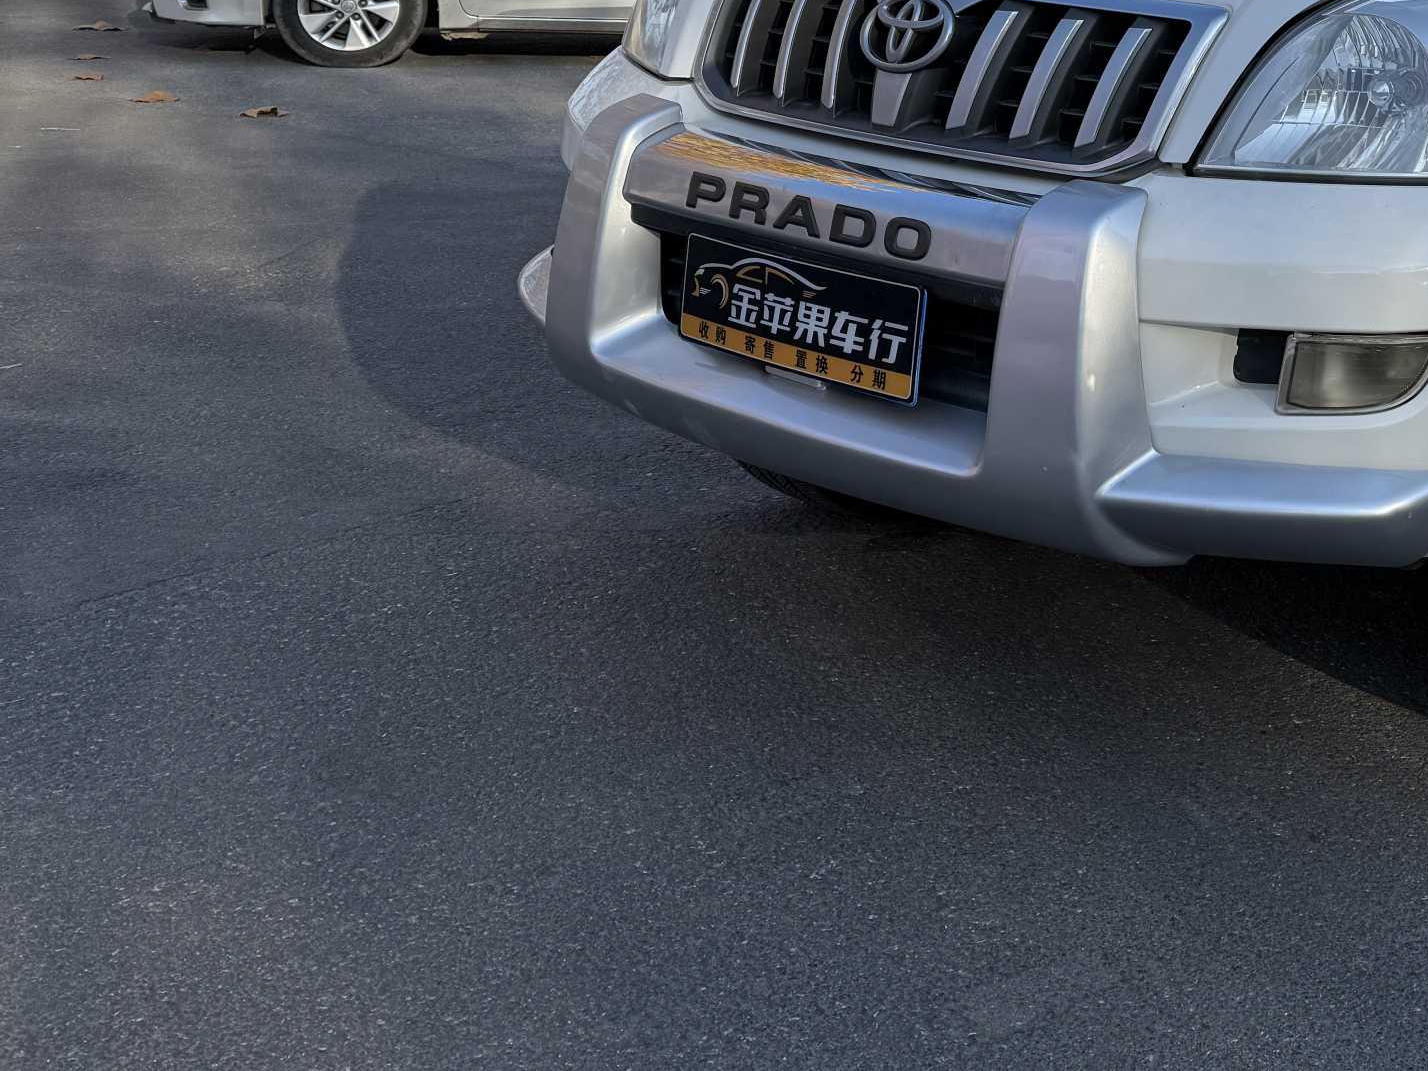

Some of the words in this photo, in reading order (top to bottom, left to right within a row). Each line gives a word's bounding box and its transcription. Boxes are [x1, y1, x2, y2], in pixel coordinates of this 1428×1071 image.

[685, 171, 932, 261] PRADO
[727, 283, 909, 364] 金苹果车行
[744, 334, 776, 360] 寄售
[794, 349, 829, 375] 置换
[850, 365, 887, 390] 分期
